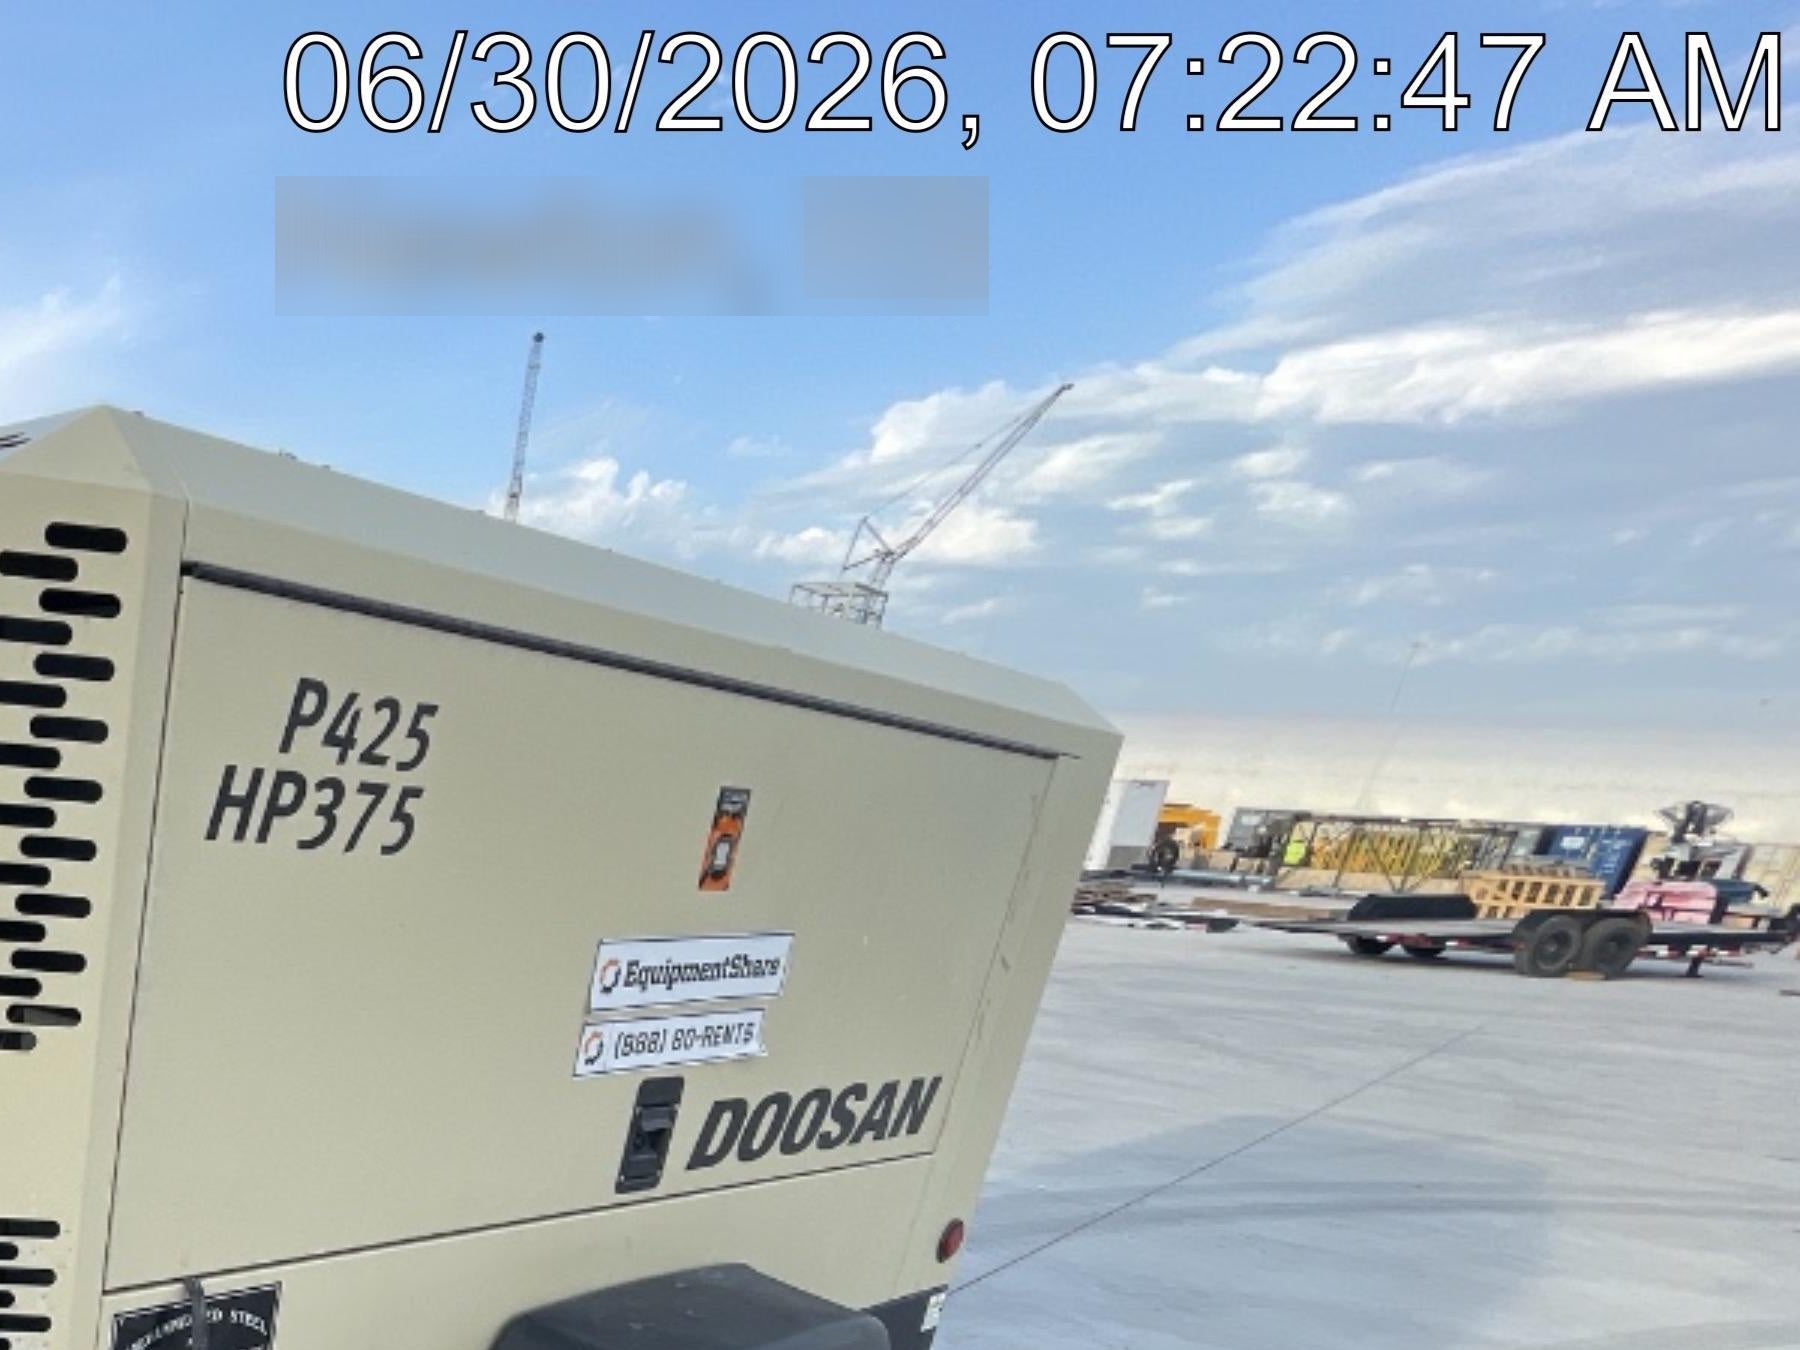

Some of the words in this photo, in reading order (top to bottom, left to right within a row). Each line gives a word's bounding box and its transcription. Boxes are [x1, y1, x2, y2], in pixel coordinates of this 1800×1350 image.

[278, 677, 439, 771] P425
[204, 764, 424, 856] HP375
[623, 953, 780, 992] EquipmentShare
[685, 1076, 943, 1170] DOOSAN
